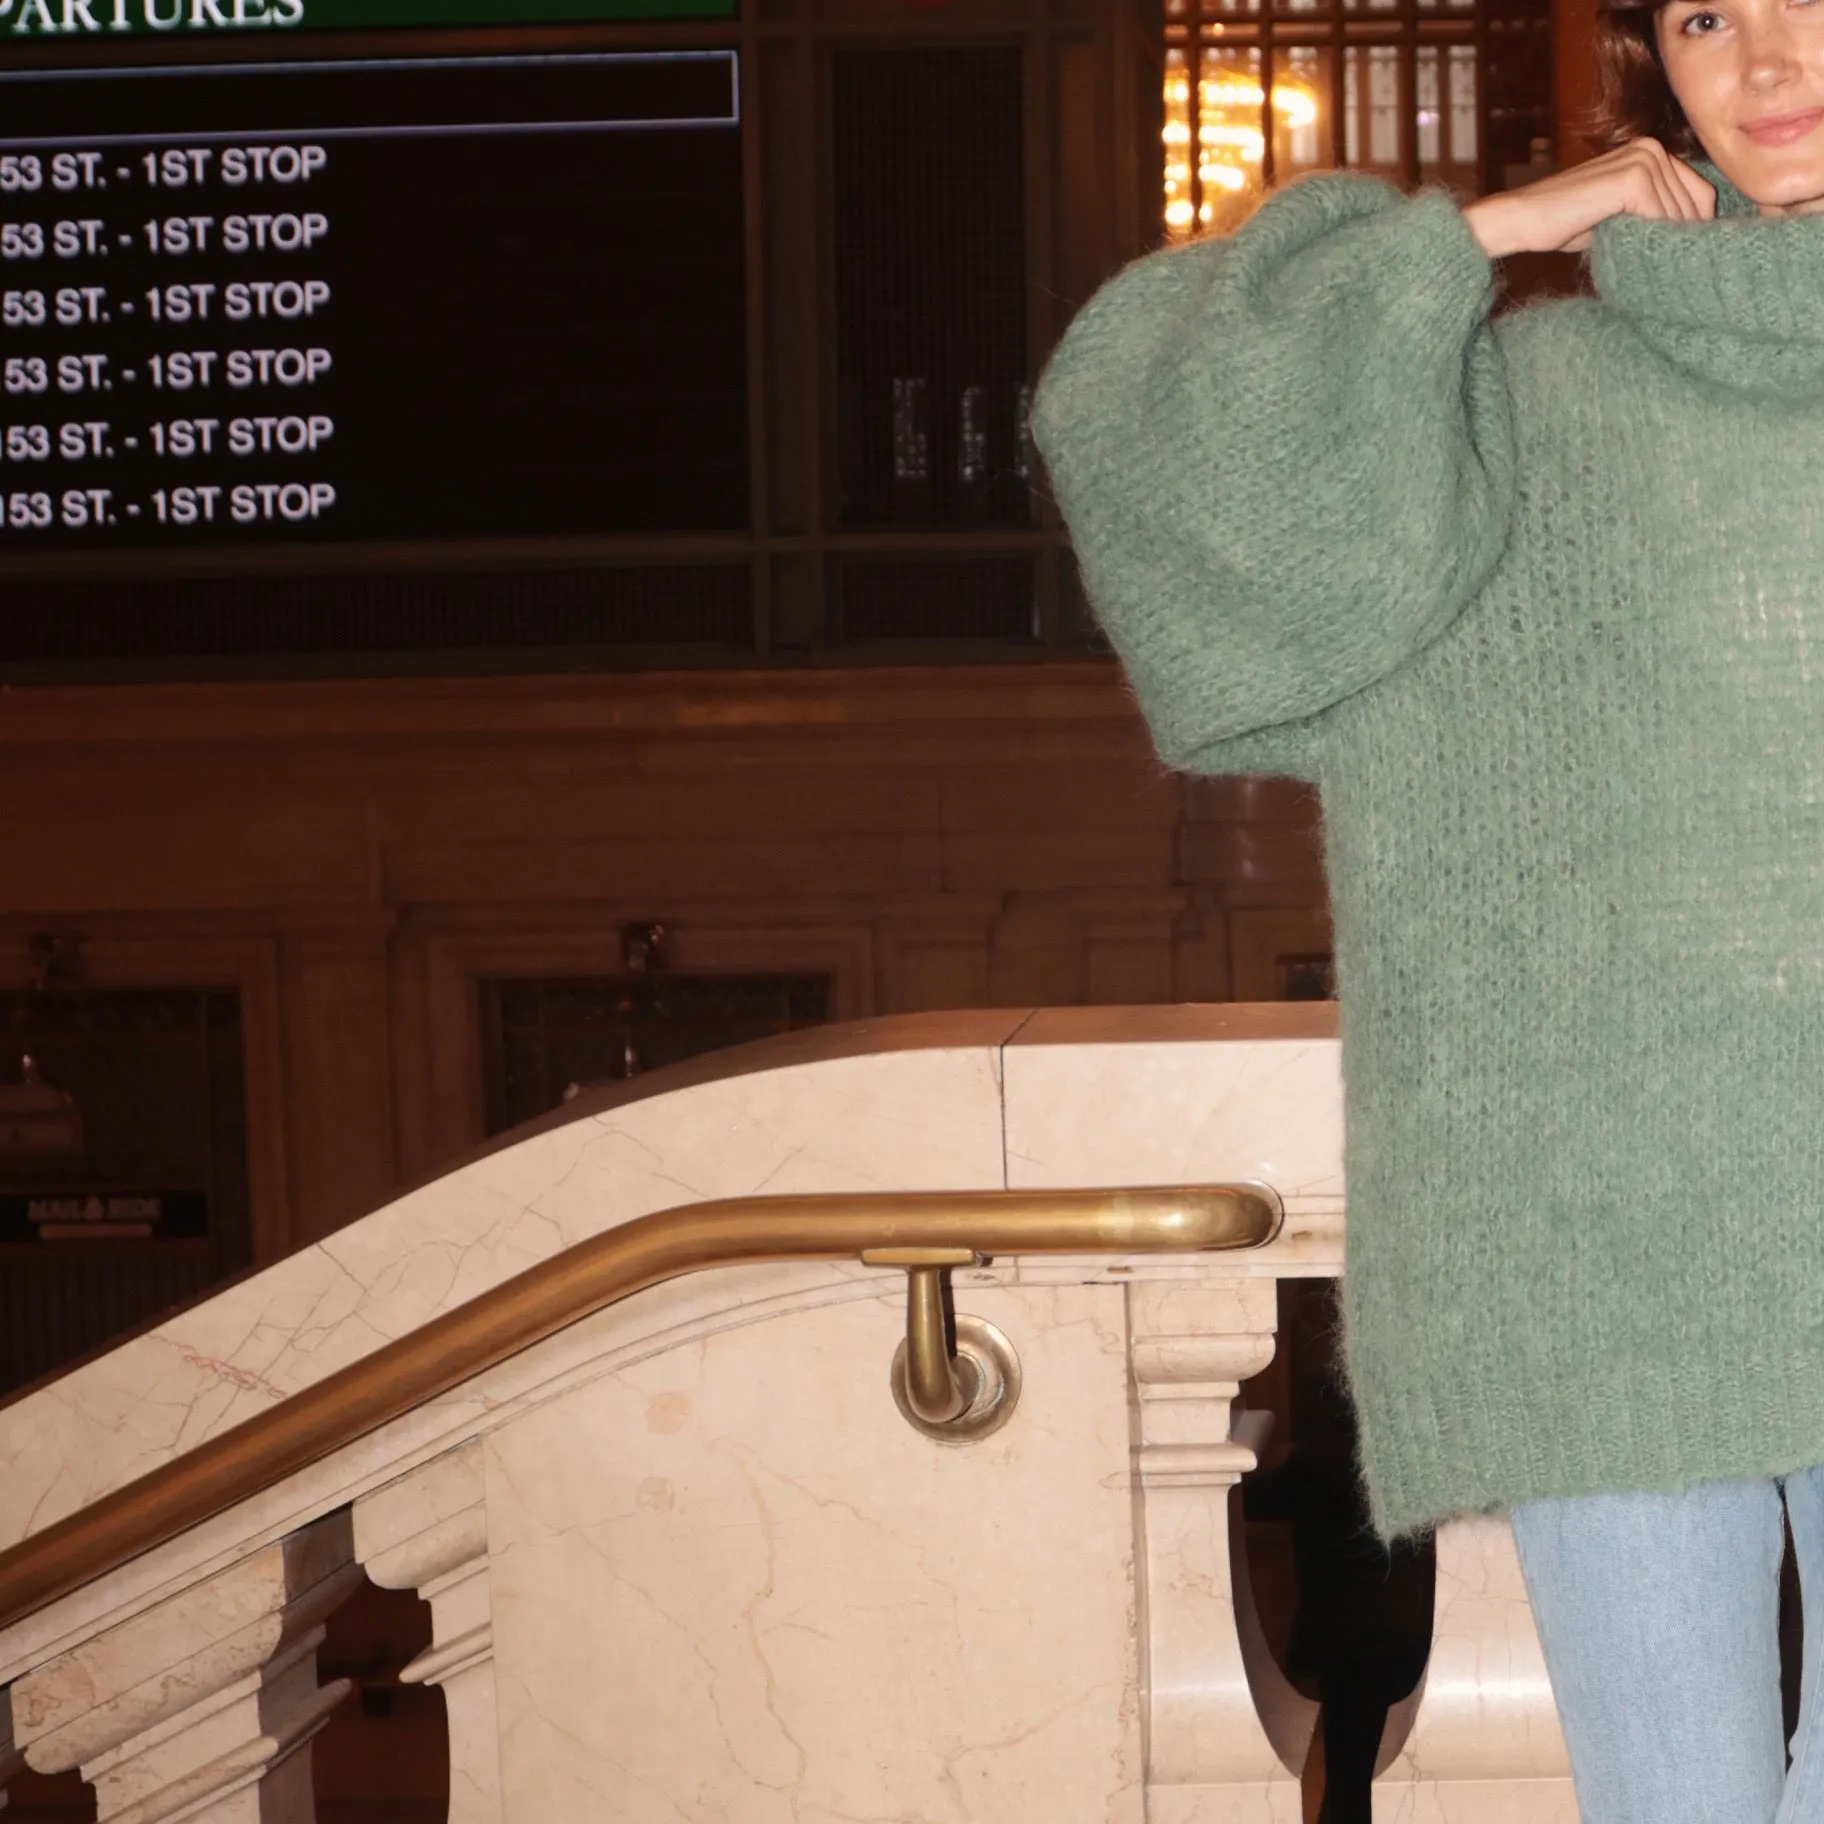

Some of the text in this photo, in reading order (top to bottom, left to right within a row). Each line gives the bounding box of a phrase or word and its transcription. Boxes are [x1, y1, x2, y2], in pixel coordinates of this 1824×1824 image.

[50, 150, 108, 190] ST.
[142, 146, 213, 187] 1ST
[220, 144, 328, 184] STOP
[52, 218, 109, 258] ST.
[143, 214, 214, 254] 1ST
[222, 212, 330, 252] STOP
[54, 285, 111, 325] ST.
[145, 281, 217, 322] 1ST
[223, 279, 331, 318] STOP
[56, 353, 113, 392] ST.
[147, 349, 218, 389] 1ST
[225, 347, 333, 386] STOP
[0, 423, 51, 461] 53
[58, 421, 115, 460] ST.
[149, 417, 220, 456] 1ST
[227, 414, 335, 454] STOP
[60, 488, 117, 527] ST.
[151, 484, 222, 524] 1ST
[229, 482, 337, 522] STOP
